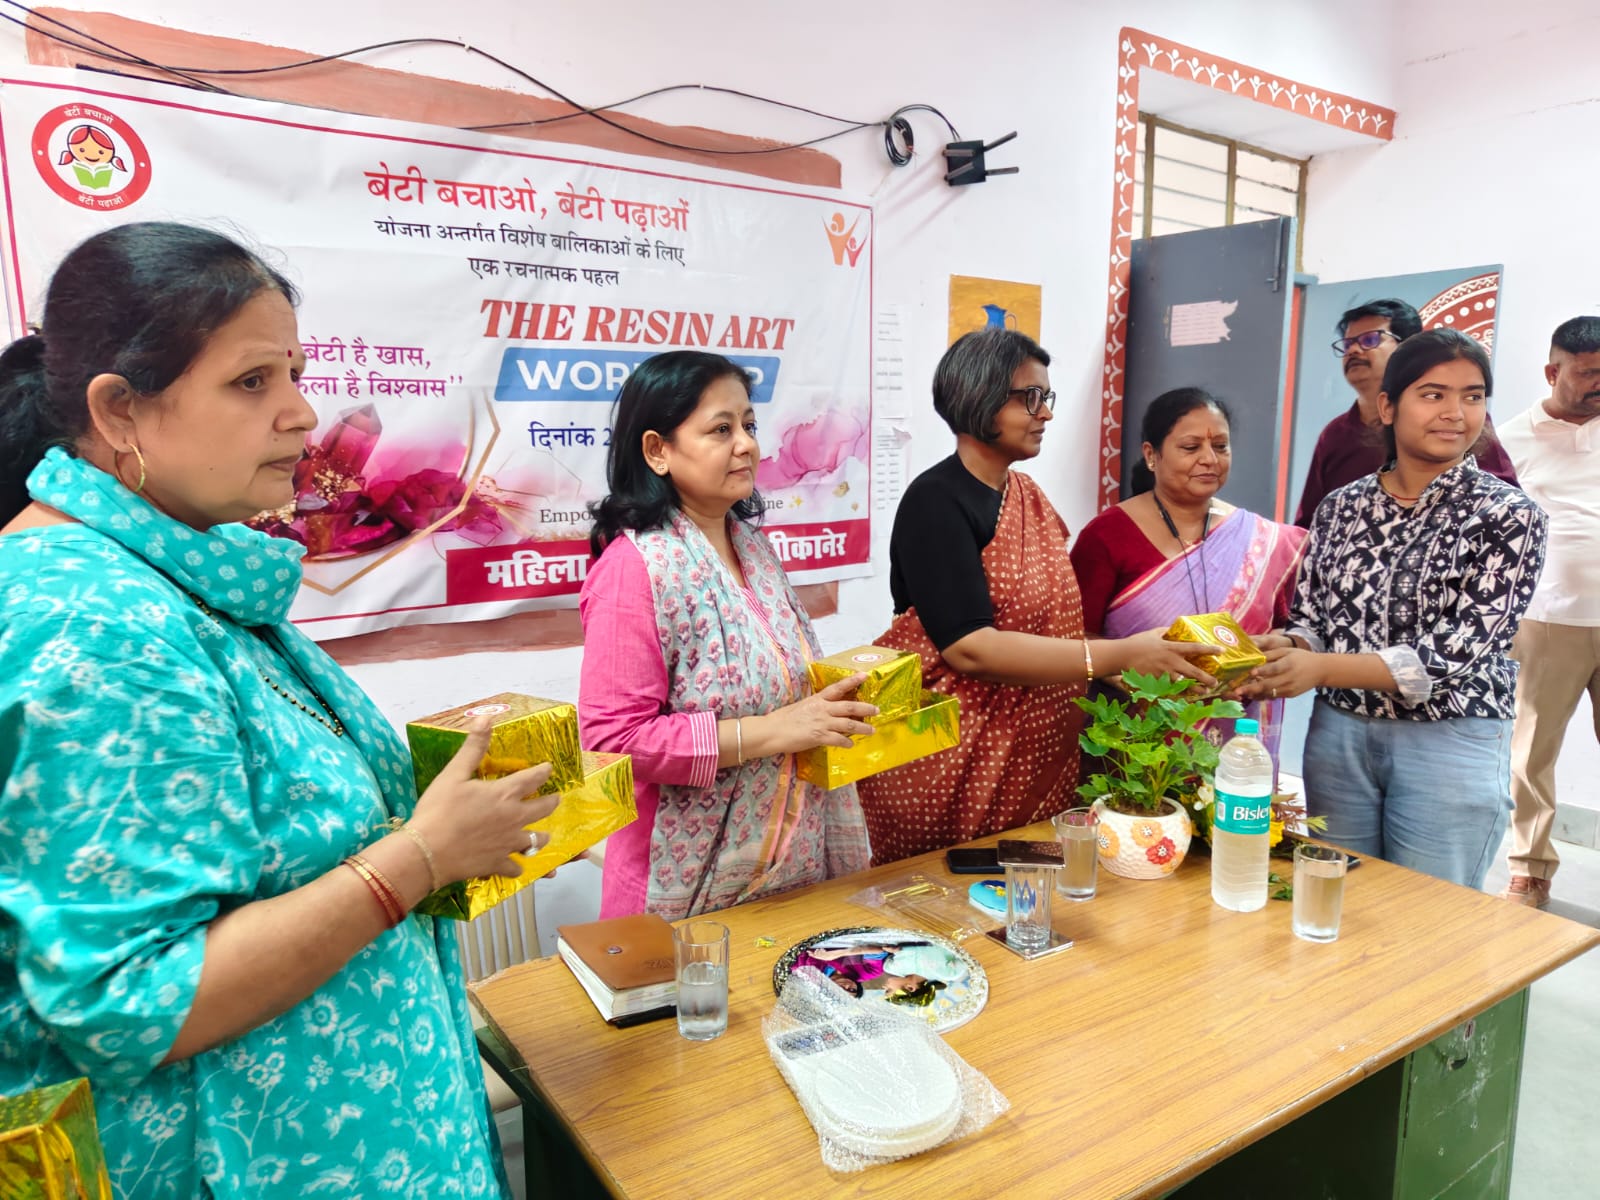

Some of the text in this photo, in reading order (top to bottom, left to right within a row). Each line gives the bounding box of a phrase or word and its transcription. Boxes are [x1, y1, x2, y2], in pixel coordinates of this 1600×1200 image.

[64, 105, 80, 118] बेटी
[364, 161, 690, 232] बेटी बचाओ, बेटी पढ़ाओं
[374, 216, 685, 267] योजना अन्तर्गत विशेष बालिकाओं के लिए
[467, 257, 619, 287] एक रचनात्मक पहल
[480, 299, 795, 350] THE RESIN ART
[300, 336, 431, 369] बेटी है खास,
[344, 369, 361, 398] है
[527, 421, 596, 450] दिनांक
[484, 550, 590, 588] महिला
